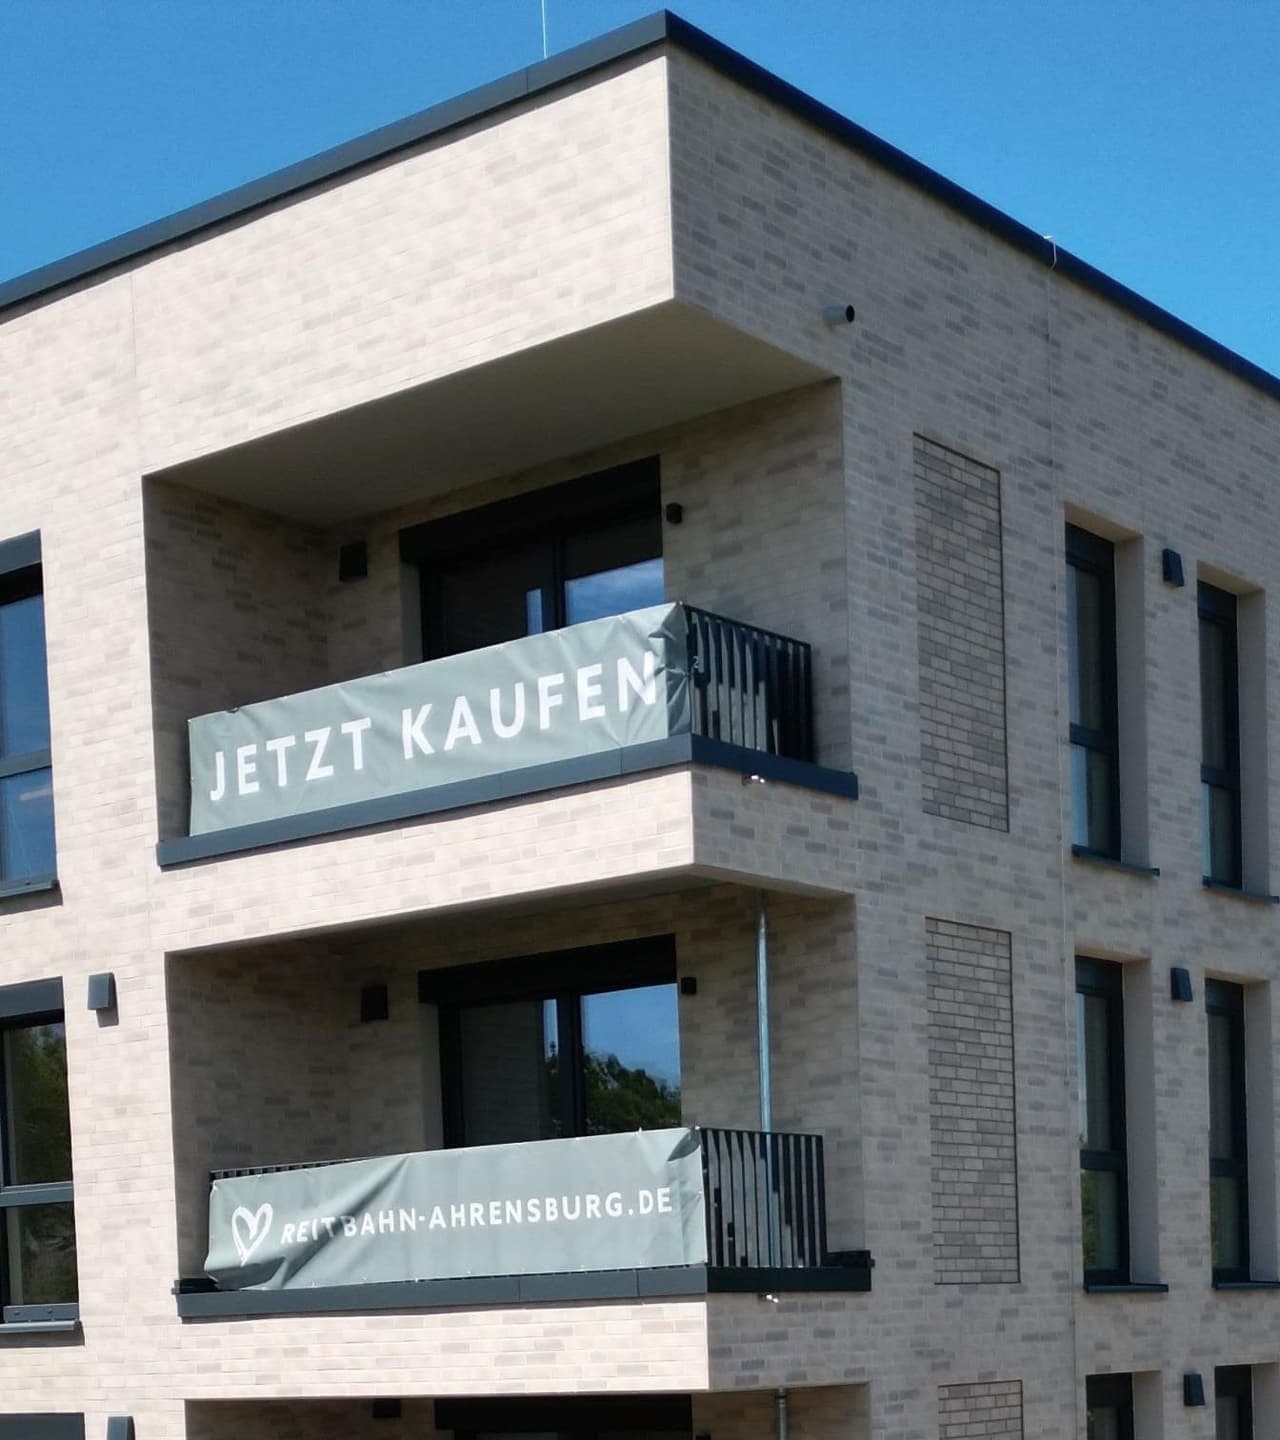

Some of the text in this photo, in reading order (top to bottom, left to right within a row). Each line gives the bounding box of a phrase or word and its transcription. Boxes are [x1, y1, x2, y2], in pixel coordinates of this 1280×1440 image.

[209, 651, 658, 802] JETZT KAUFEN
[280, 1187, 673, 1246] REITBAHN-AHRENSBURG.DE
